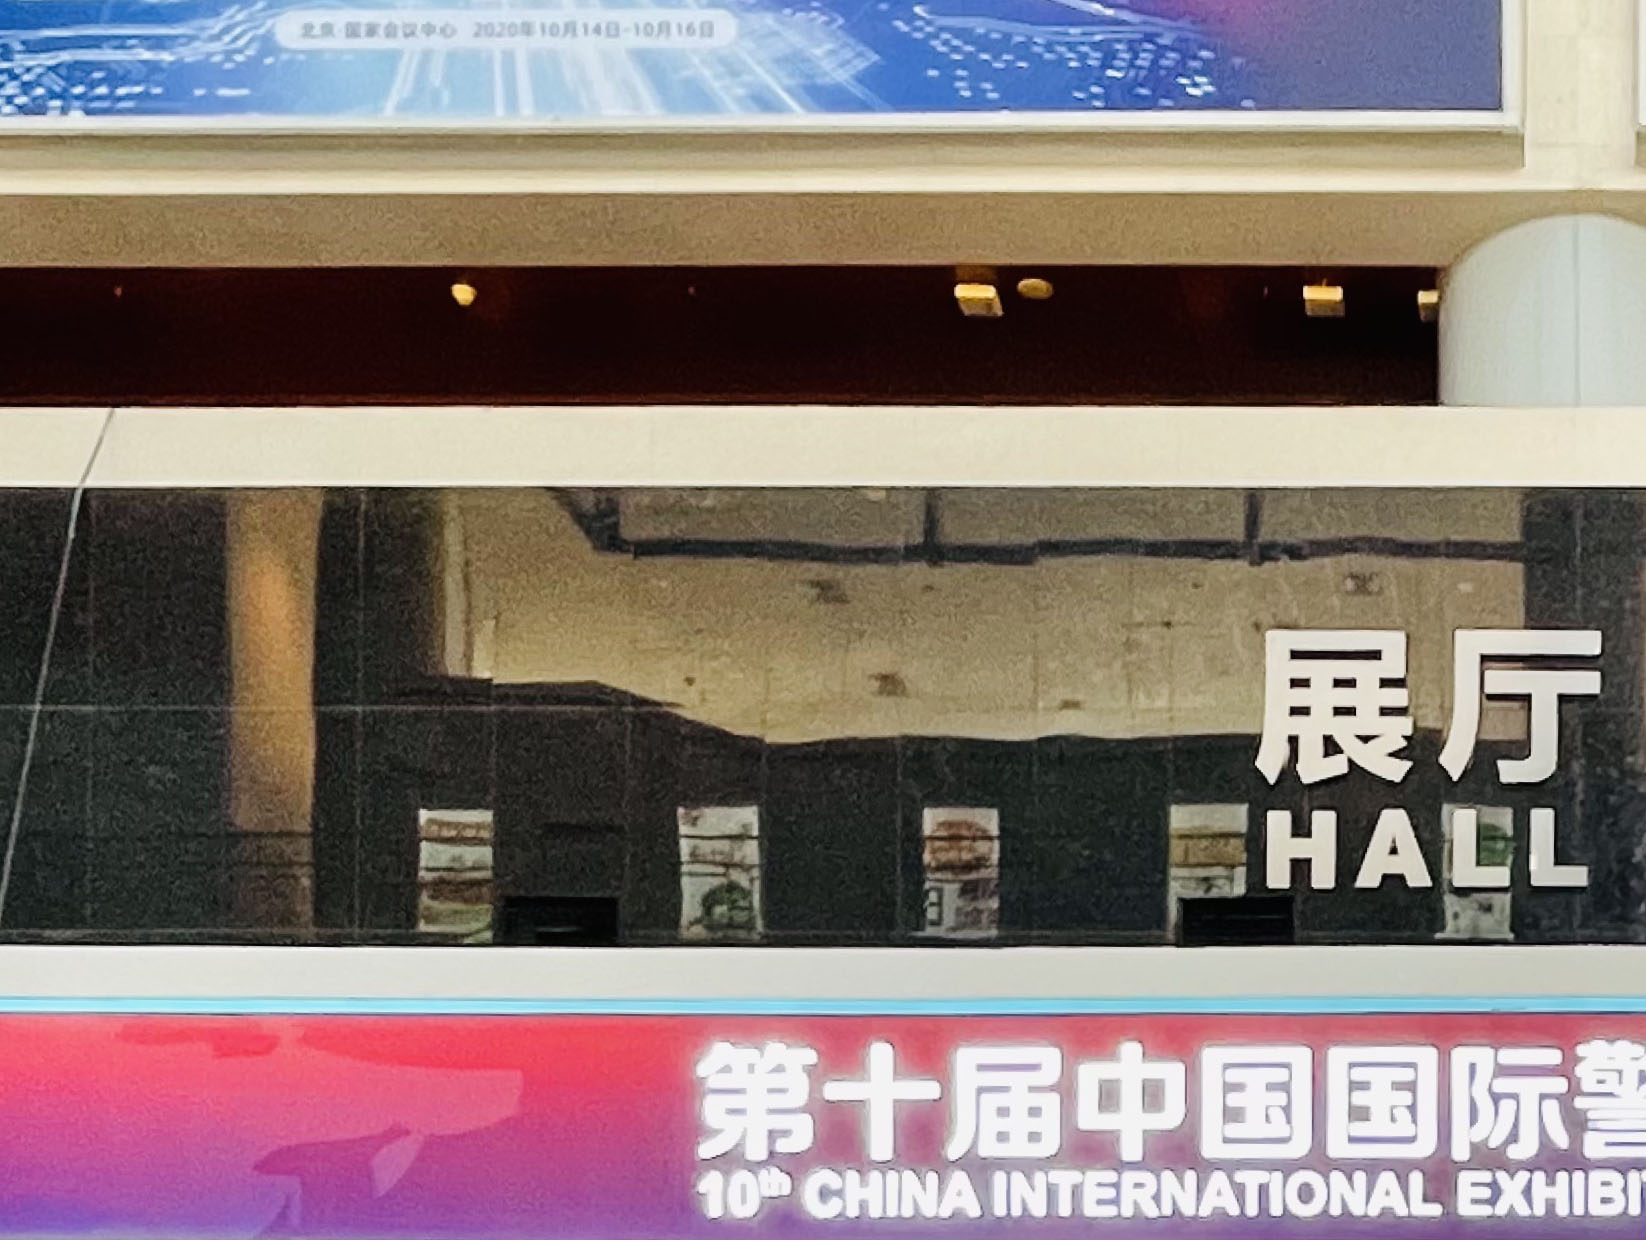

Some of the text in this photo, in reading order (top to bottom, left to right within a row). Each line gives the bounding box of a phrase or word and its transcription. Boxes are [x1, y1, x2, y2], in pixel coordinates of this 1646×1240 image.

[1255, 629, 1602, 786] 展厅
[1266, 808, 1589, 889] HALL
[696, 1167, 793, 1220] 10th
[804, 1169, 982, 1220] CHINA
[994, 1169, 1444, 1220] INTERNATIONAL
